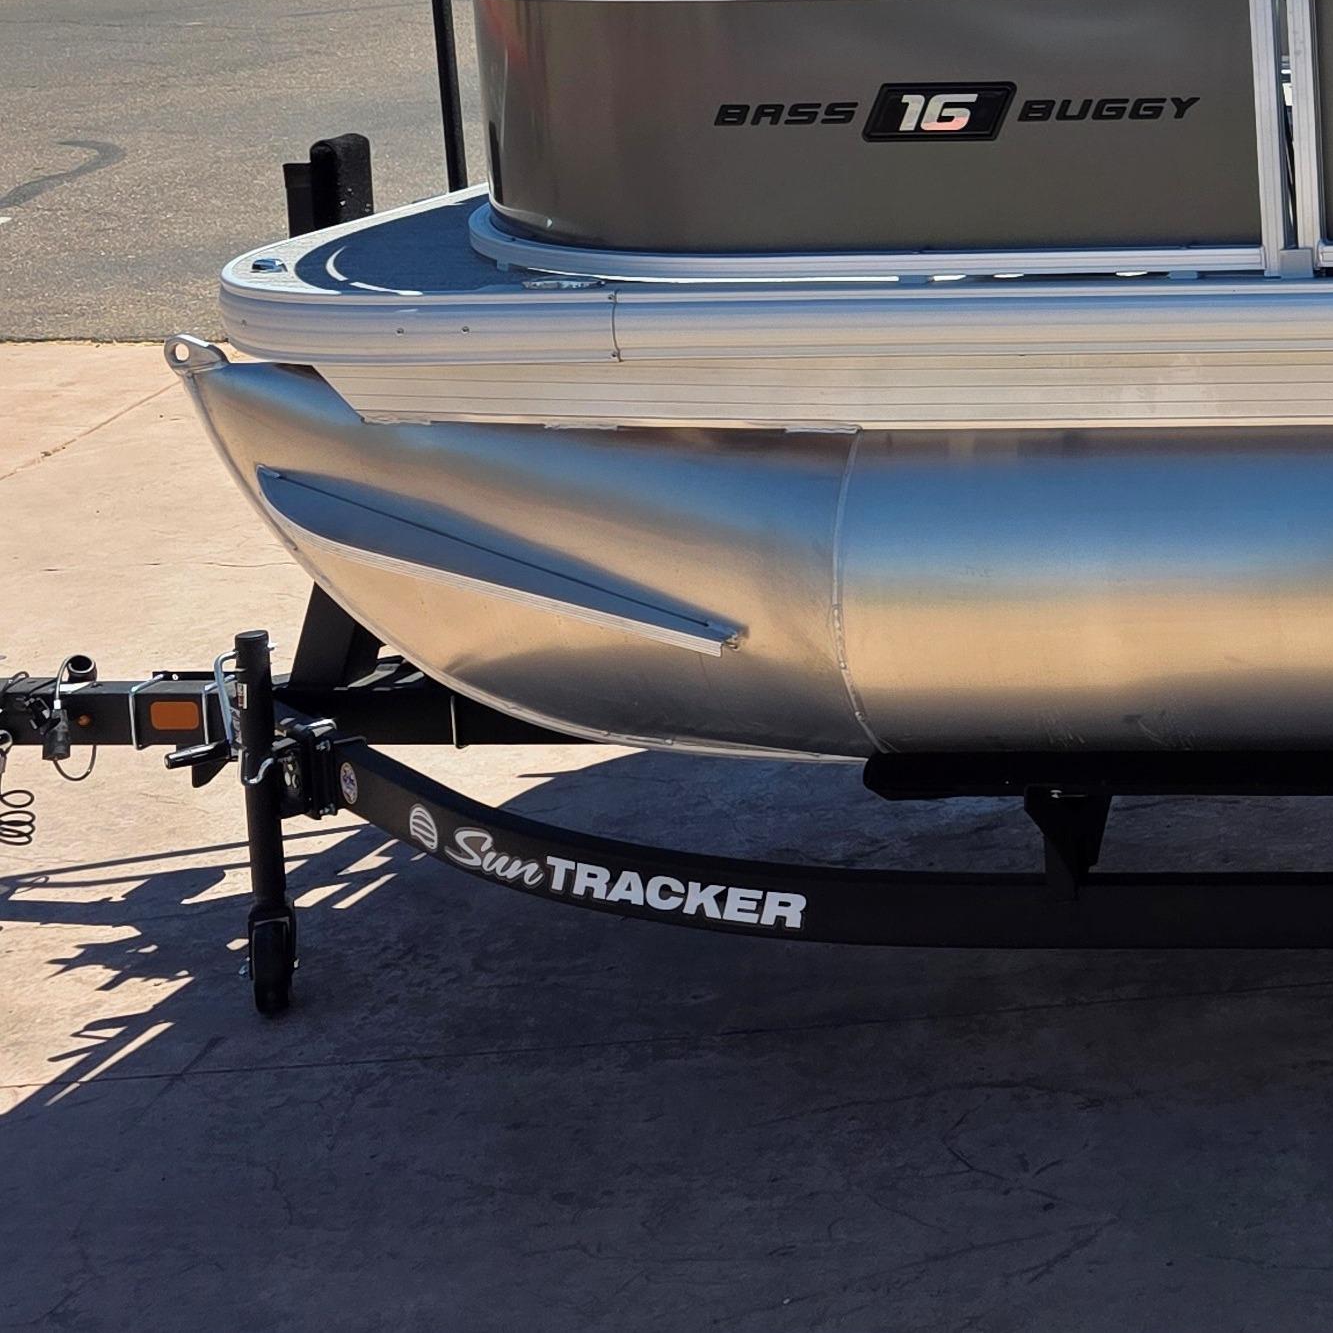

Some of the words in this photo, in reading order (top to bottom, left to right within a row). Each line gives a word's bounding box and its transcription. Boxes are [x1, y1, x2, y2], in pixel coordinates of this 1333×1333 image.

[713, 101, 859, 127] BASS
[899, 93, 979, 132] 16
[1018, 96, 1200, 123] BUGGY
[444, 828, 546, 887] Sun
[545, 855, 808, 929] TRACKER
